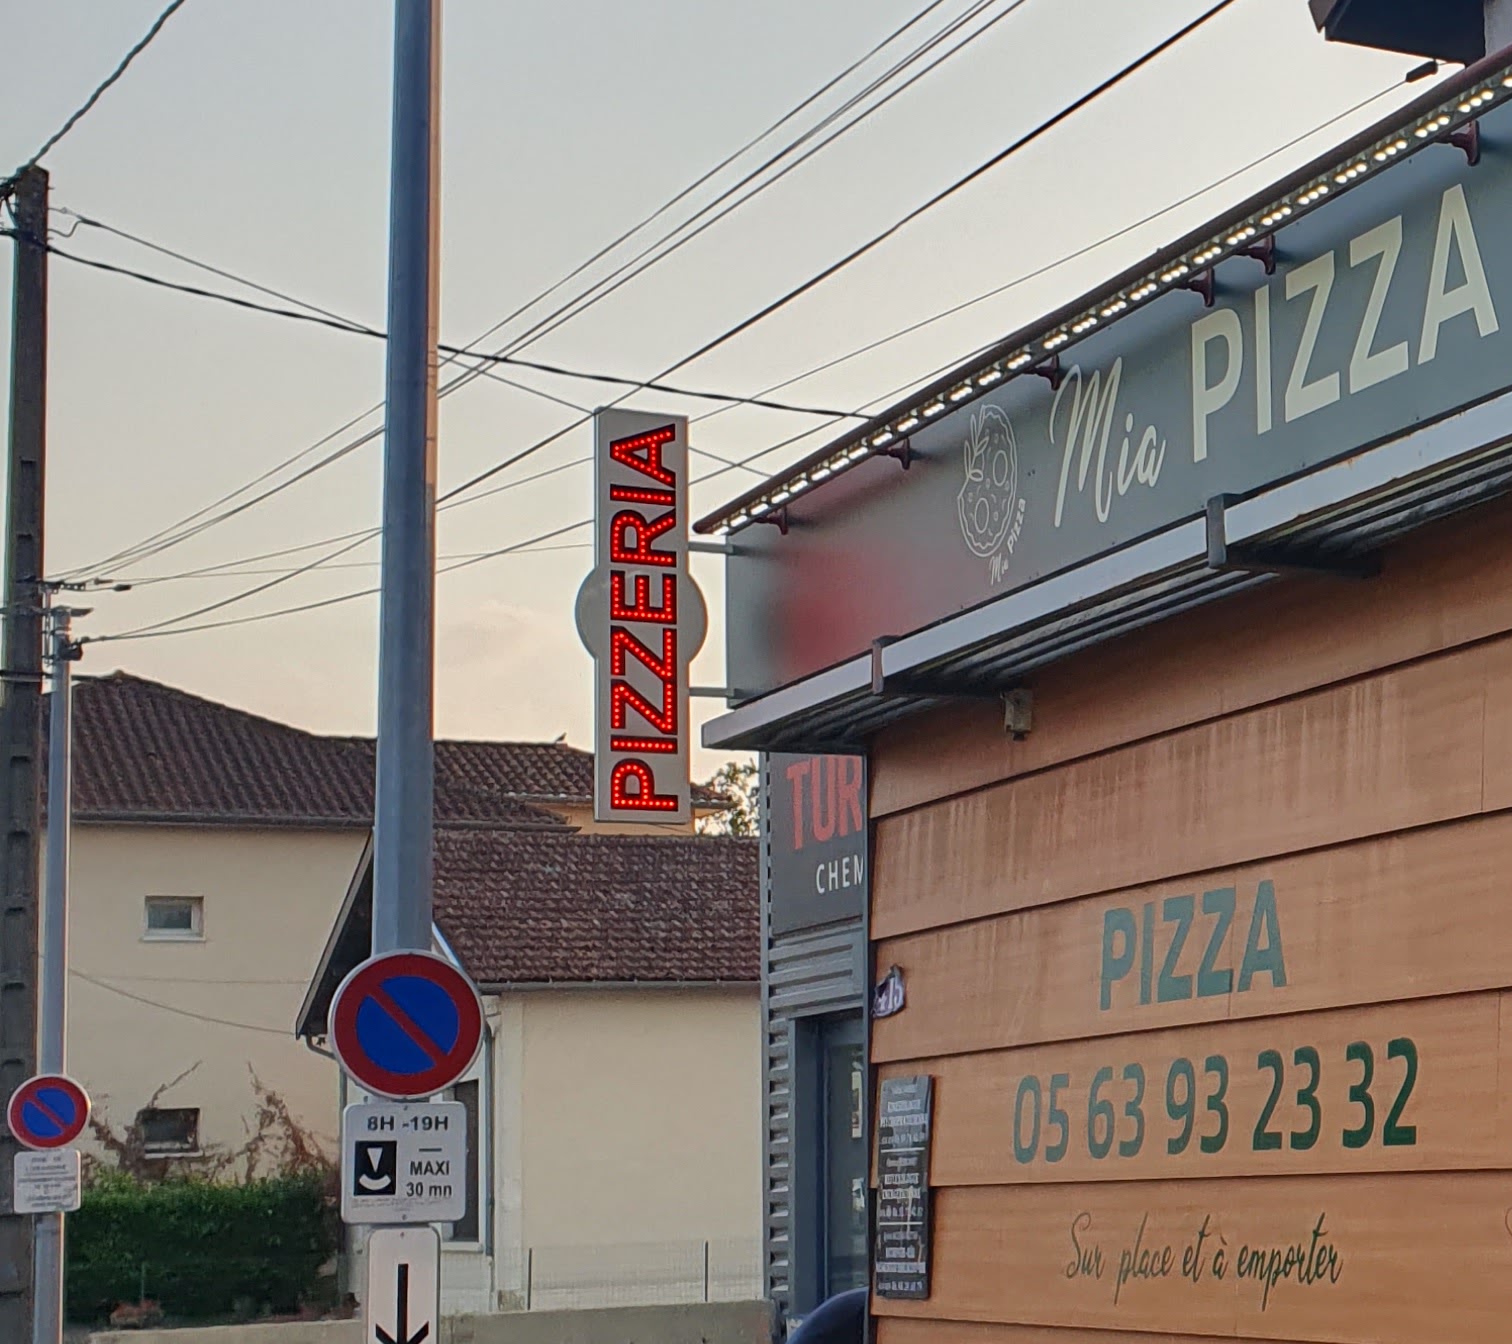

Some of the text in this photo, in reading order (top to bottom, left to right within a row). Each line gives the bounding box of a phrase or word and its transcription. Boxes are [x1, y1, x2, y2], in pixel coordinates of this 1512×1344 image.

[1050, 184, 1499, 528] Mia PIZZA
[610, 423, 678, 812] PIZZERIA
[1100, 880, 1287, 1011] PIZZA
[368, 1116, 394, 1131] 8H
[1013, 1073, 1070, 1163] 05
[1087, 1062, 1145, 1159] 63
[1166, 1055, 1229, 1154] 93
[1252, 1046, 1322, 1150] 23
[1342, 1037, 1418, 1148] 32
[407, 1182, 452, 1197] 30 mn
[409, 1161, 450, 1176] MAXI
[1065, 1211, 1344, 1312] Sur place et à emporter
